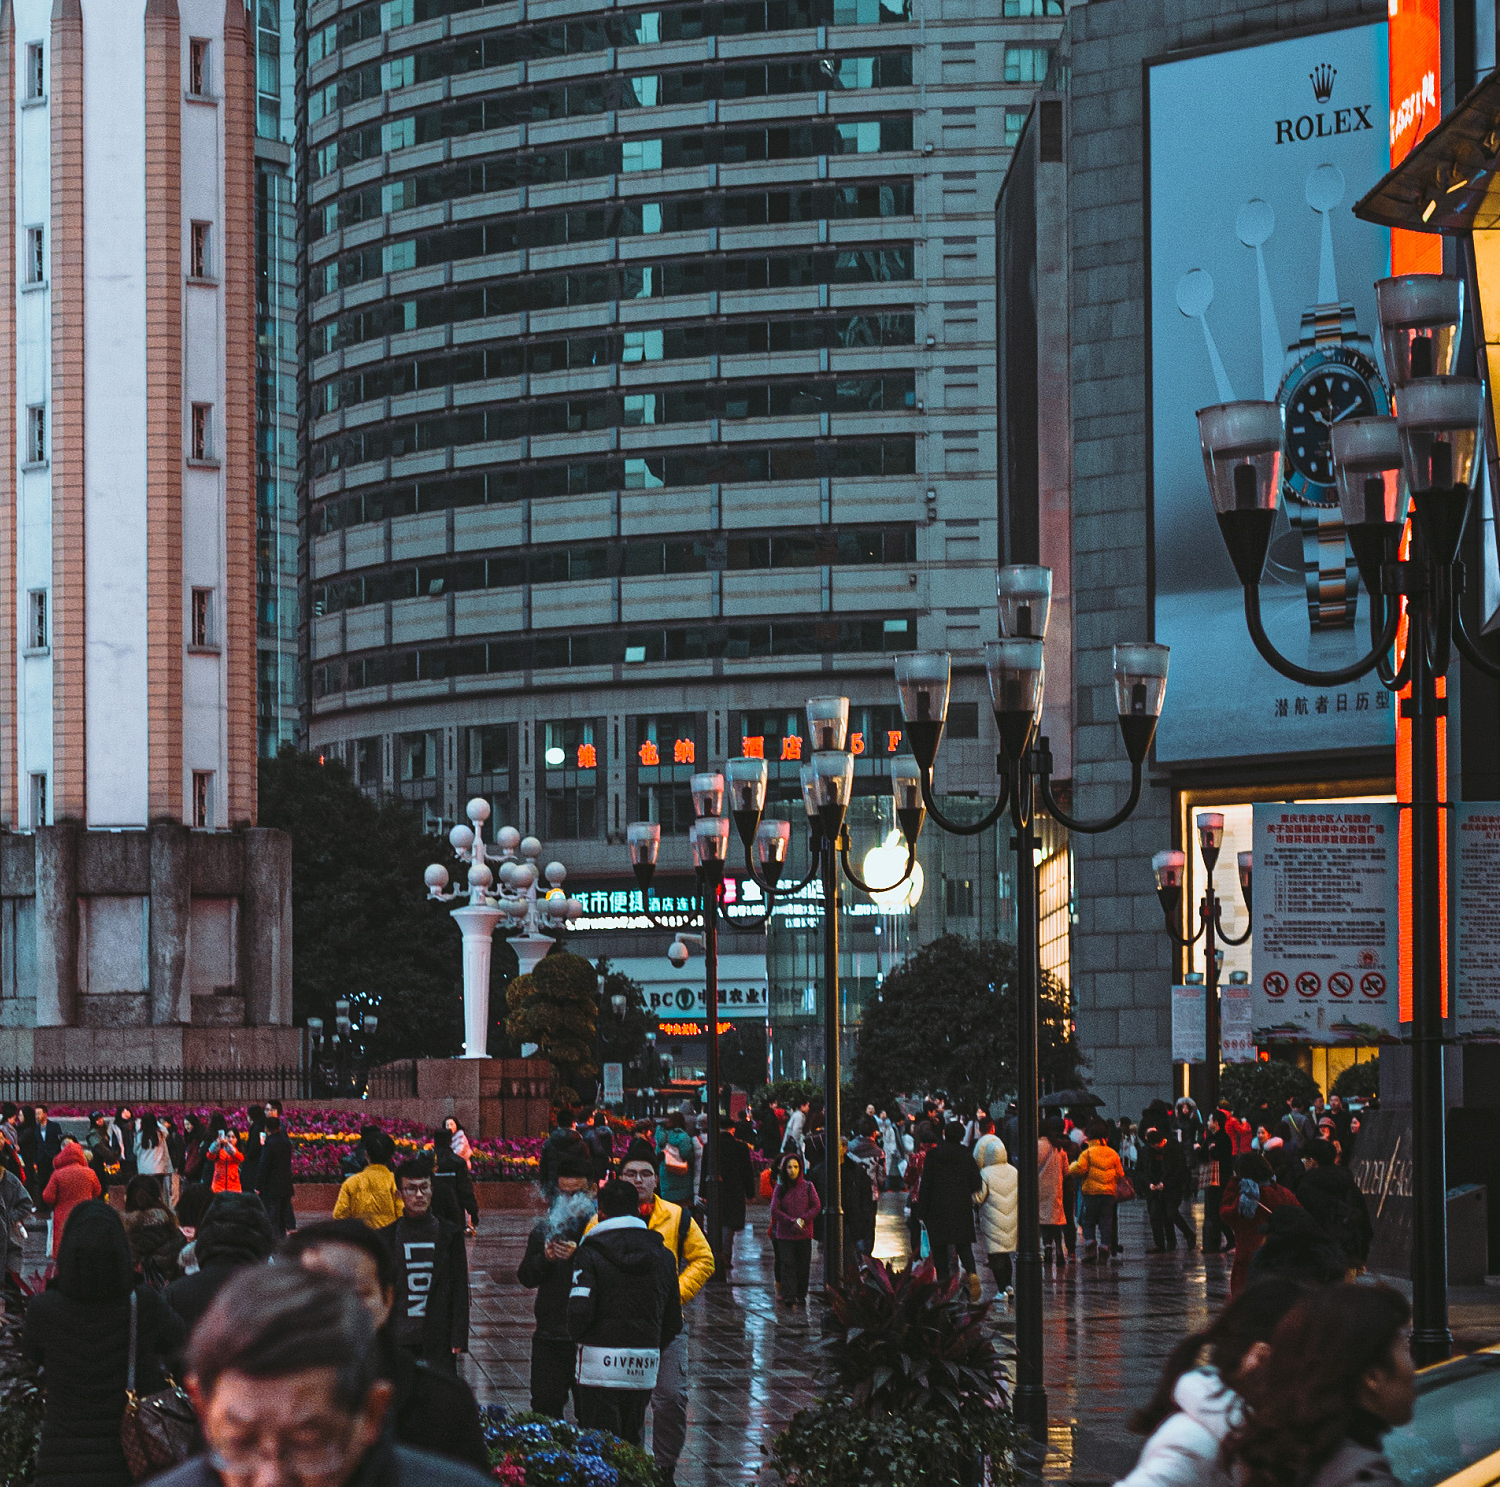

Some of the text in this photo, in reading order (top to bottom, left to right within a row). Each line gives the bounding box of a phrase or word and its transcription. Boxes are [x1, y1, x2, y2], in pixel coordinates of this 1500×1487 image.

[1274, 104, 1374, 145] ROLEX
[1274, 691, 1390, 718] 潜航者日历型
[577, 734, 803, 768] 维也纳酒店
[403, 1242, 436, 1317] LION
